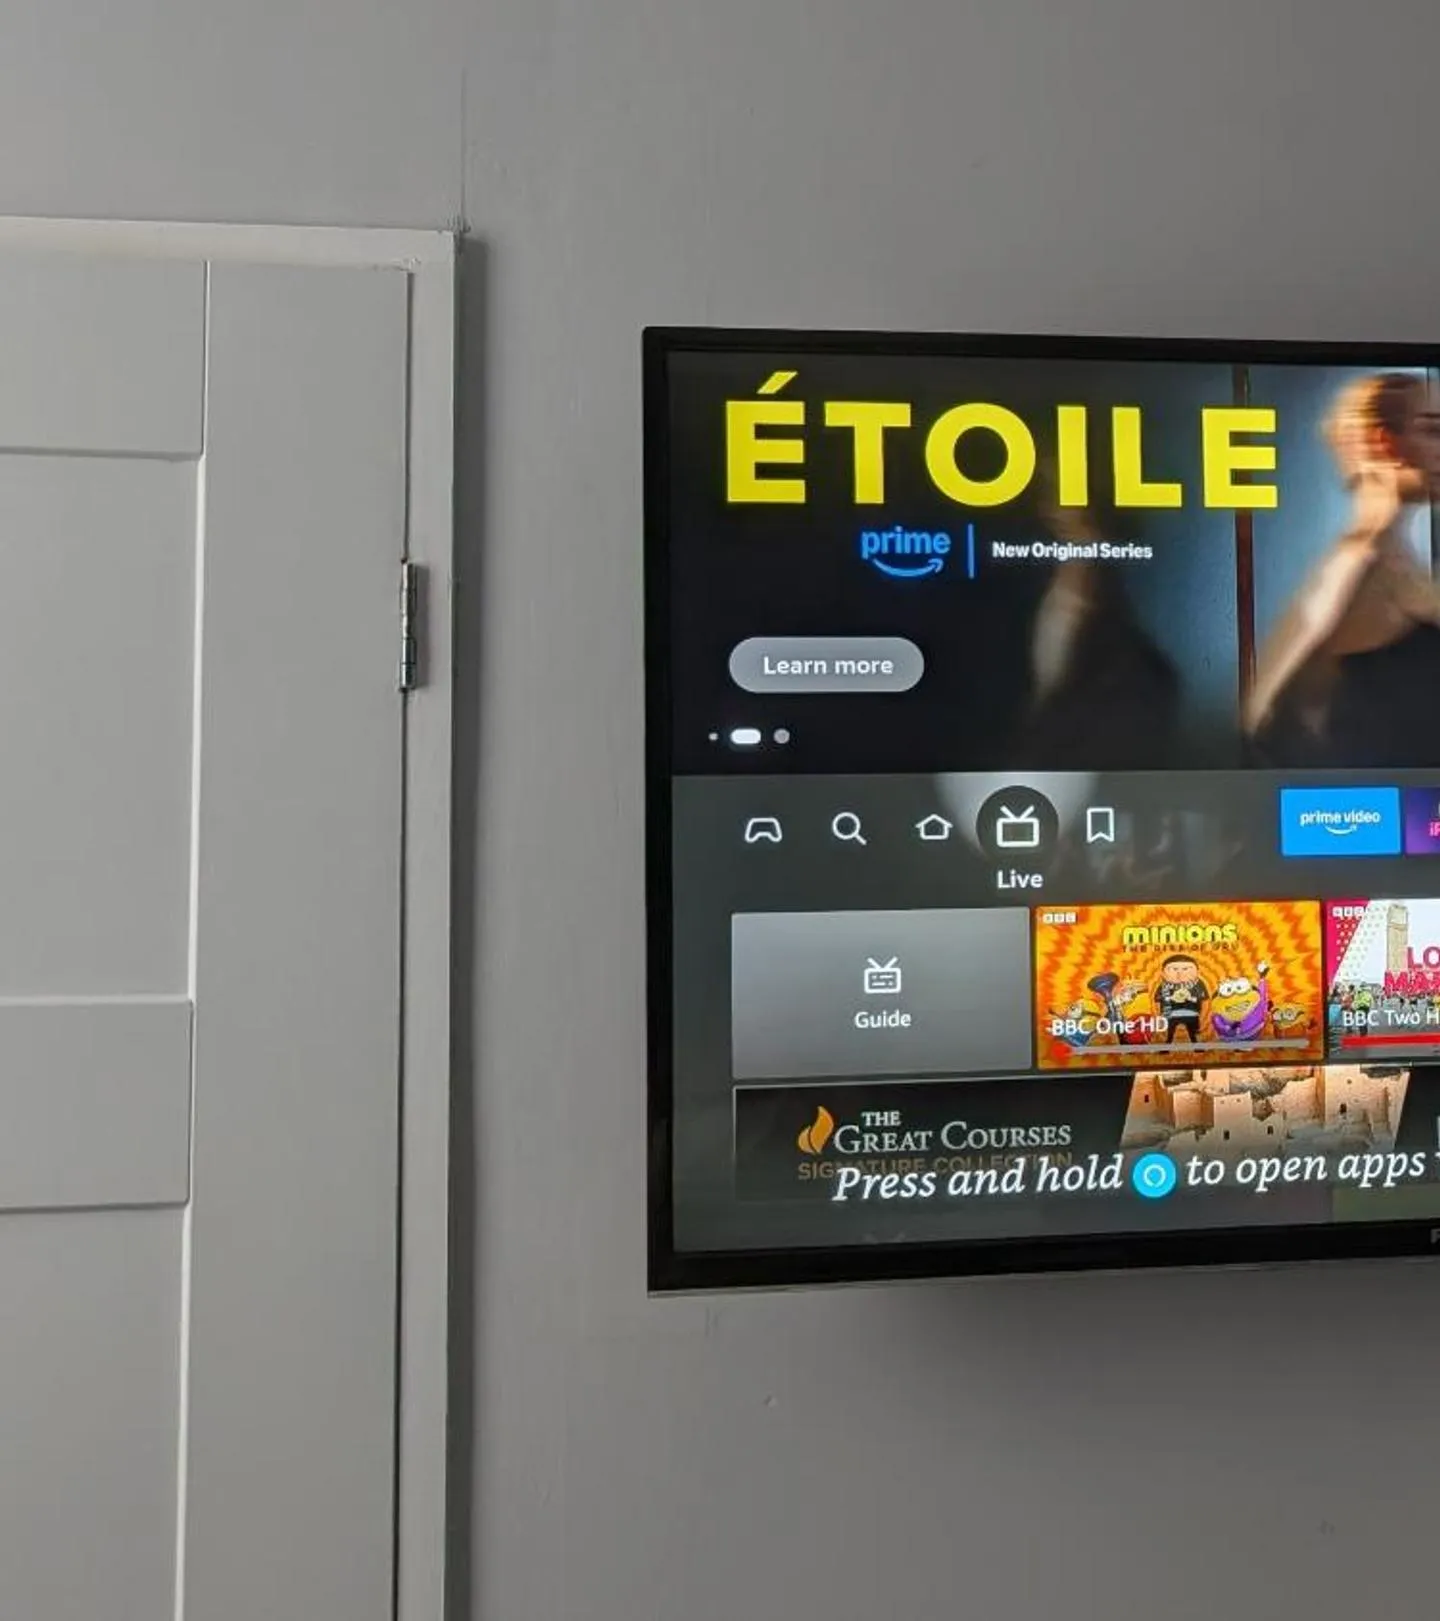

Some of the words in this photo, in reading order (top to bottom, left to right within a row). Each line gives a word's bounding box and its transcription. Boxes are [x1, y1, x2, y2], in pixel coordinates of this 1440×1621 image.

[726, 371, 1278, 508] ÉTOILE
[861, 526, 951, 560] prime
[992, 541, 1031, 559] New
[1032, 541, 1098, 561] Original
[1100, 542, 1154, 559] Series
[763, 655, 828, 676] Learn
[834, 657, 894, 676] more
[1300, 811, 1342, 828] prime
[1344, 808, 1381, 824] video
[997, 869, 1044, 890] Live
[854, 1009, 912, 1029] Guide
[1051, 1018, 1091, 1036] BBC
[1096, 1017, 1135, 1035] One
[1140, 1016, 1169, 1033] HD
[1343, 1010, 1379, 1027] BBC
[1384, 1009, 1421, 1026] Two
[861, 1110, 902, 1127] THE
[833, 1124, 933, 1154] GREAT
[940, 1120, 1073, 1150] COURSES
[798, 1157, 926, 1180] SIGATURE
[831, 1167, 937, 1201] Press
[947, 1155, 1026, 1196] and
[1035, 1153, 1125, 1192] hold
[1187, 1156, 1228, 1186] to
[1235, 1153, 1328, 1192] open
[1337, 1149, 1426, 1189] apps
